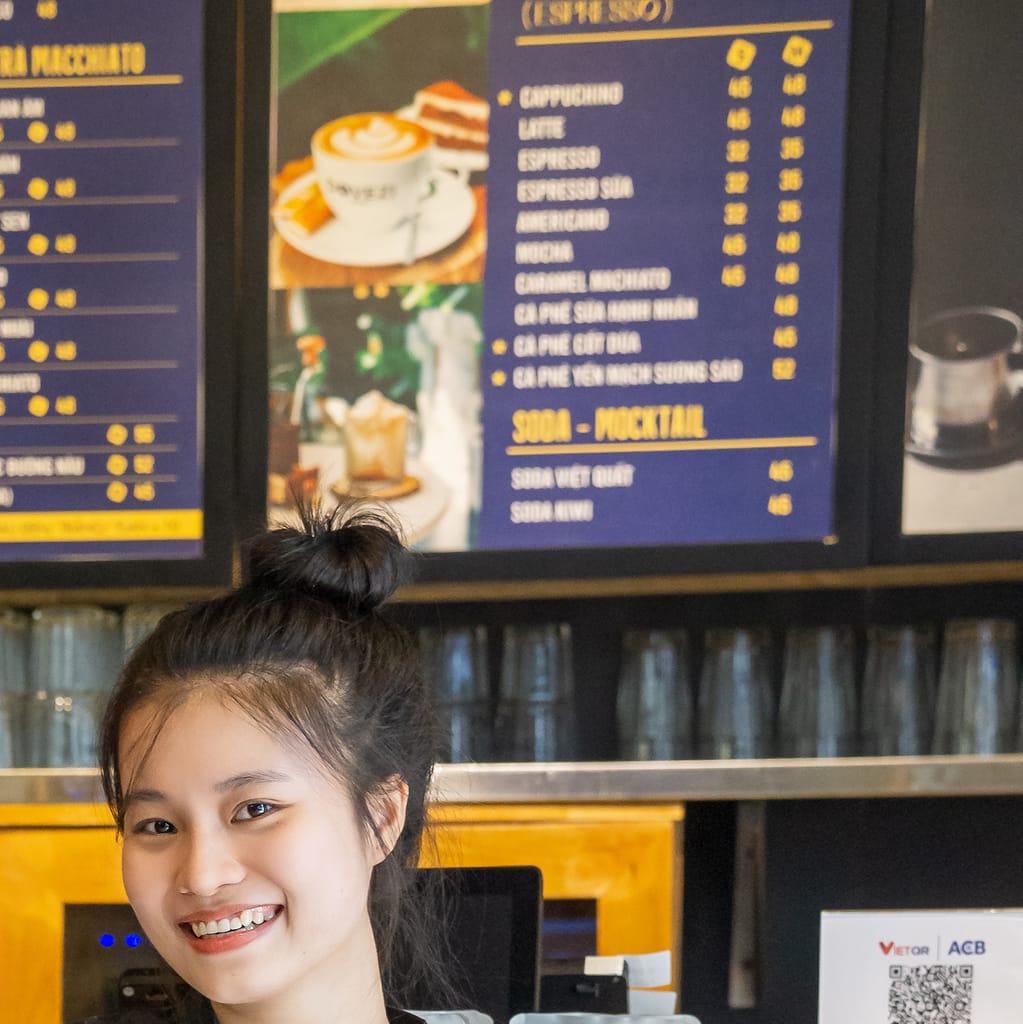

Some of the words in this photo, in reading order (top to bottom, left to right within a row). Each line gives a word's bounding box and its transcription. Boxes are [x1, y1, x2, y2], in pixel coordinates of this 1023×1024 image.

[31, 42, 146, 77] MACCHIATO
[518, 115, 566, 141] LATTE
[517, 146, 600, 172] ESPRESSO
[517, 177, 599, 203] ESPRESSO
[511, 408, 572, 443] SODA
[595, 405, 707, 441] MOCKTAIL
[948, 940, 986, 956] ACB
